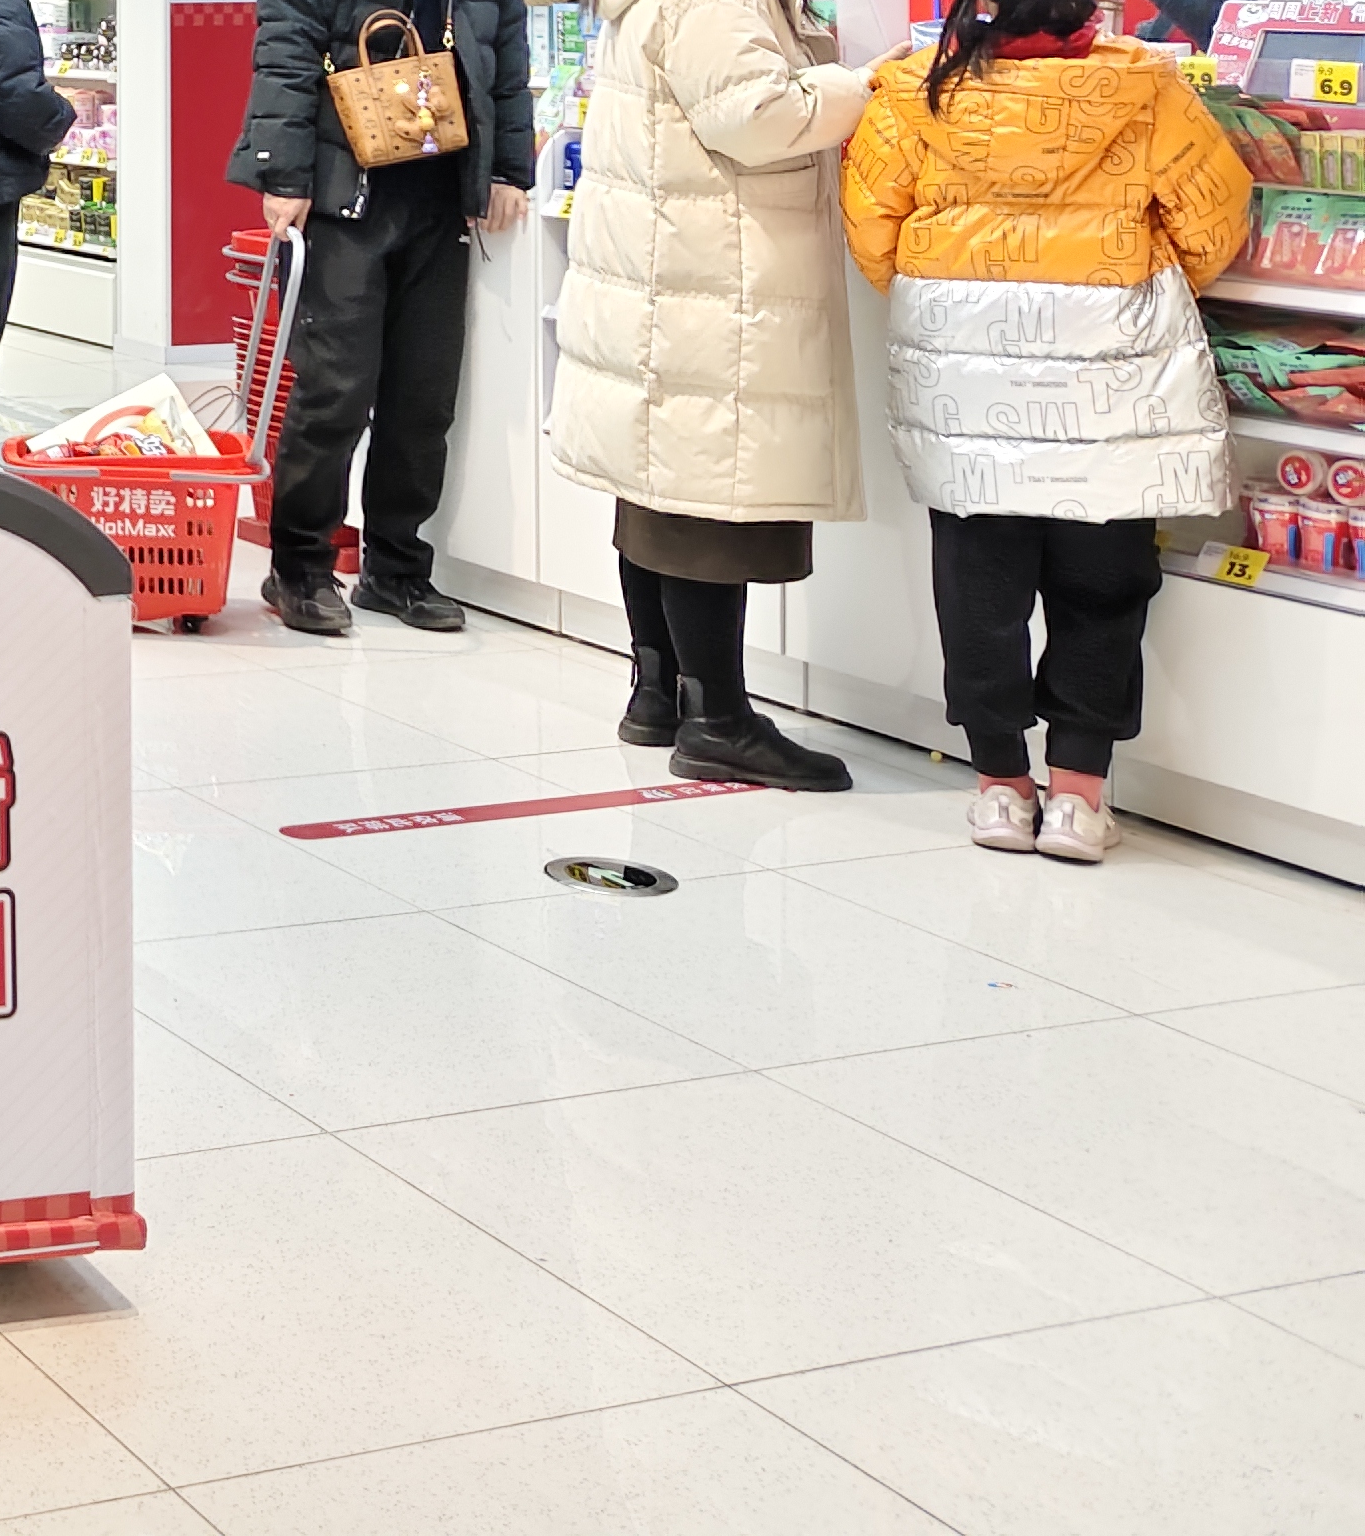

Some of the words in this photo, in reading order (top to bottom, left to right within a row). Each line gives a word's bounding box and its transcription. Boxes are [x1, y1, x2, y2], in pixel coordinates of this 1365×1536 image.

[1268, 0, 1343, 24] 周周上新
[1320, 78, 1353, 97] 6.9
[90, 486, 177, 515] 好特卖
